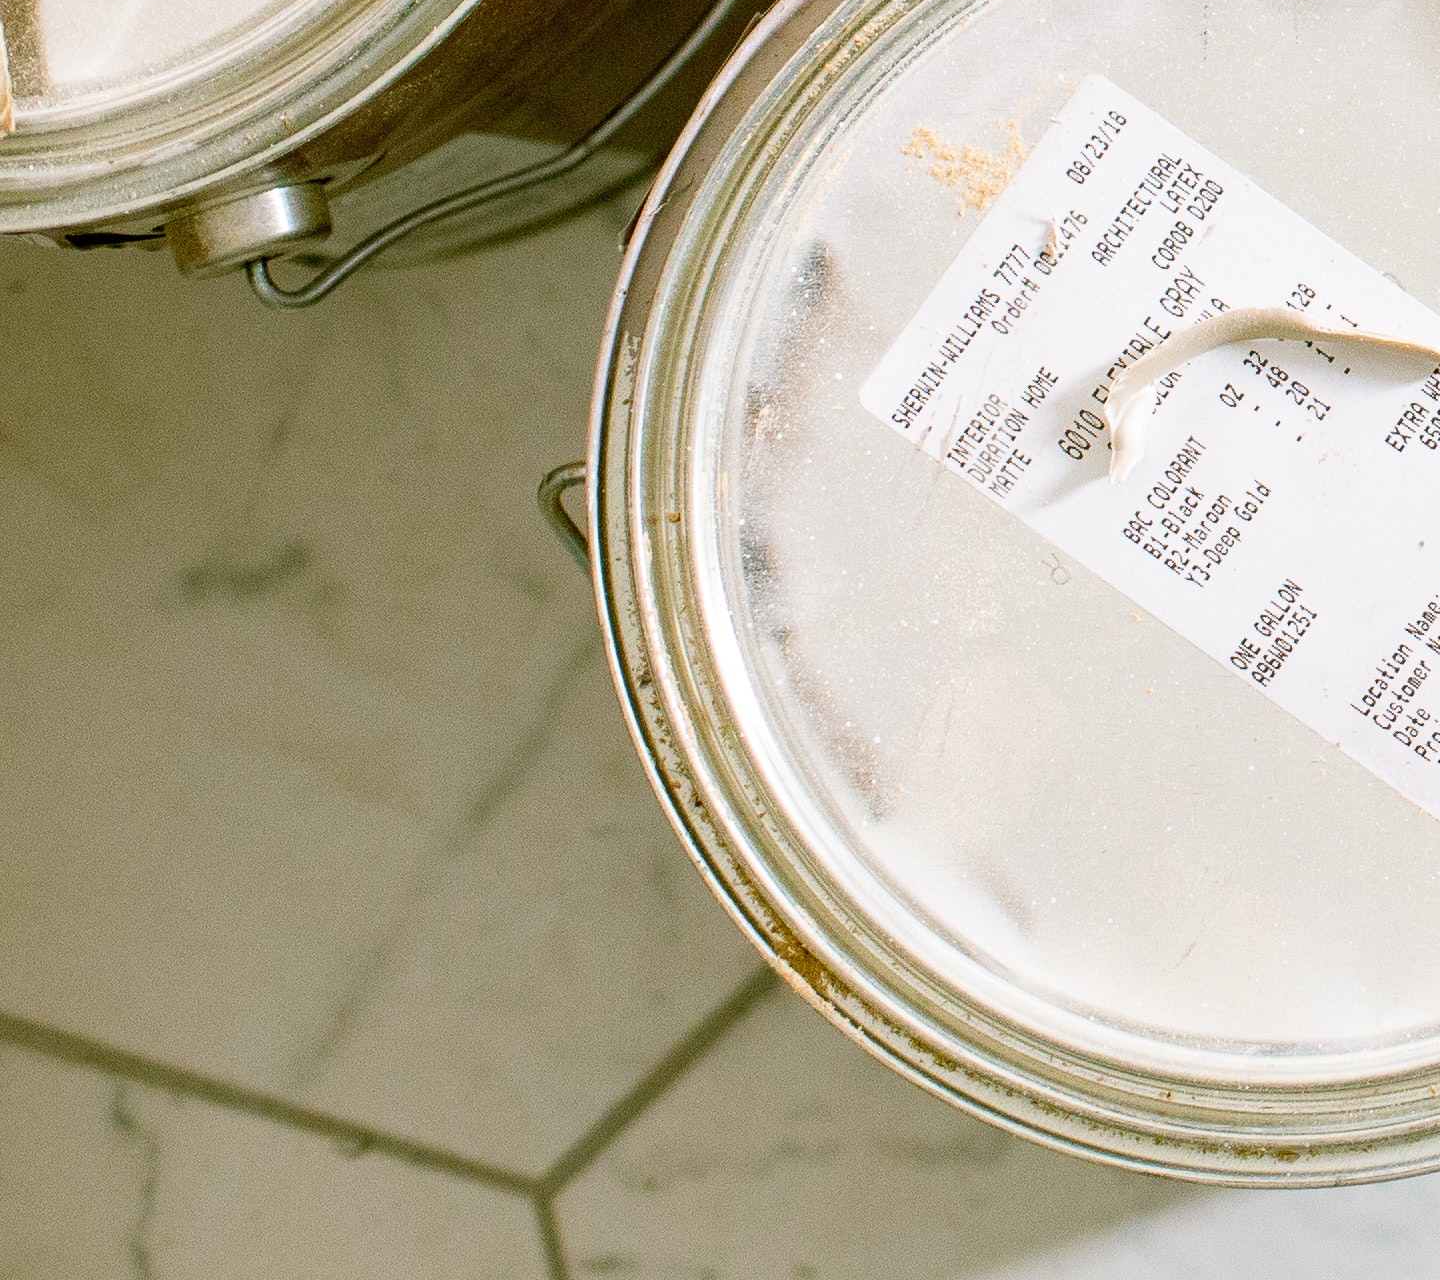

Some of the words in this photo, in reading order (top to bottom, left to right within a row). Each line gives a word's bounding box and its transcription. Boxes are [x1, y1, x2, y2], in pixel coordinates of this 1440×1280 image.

[890, 287, 1001, 429] SHERWIN-WILLIAMS
[991, 243, 1031, 286] 7777
[1064, 109, 1127, 185] 08/23/18
[945, 393, 1008, 469] INTERIOR
[1090, 152, 1183, 267] ARCHITECTURAL
[965, 406, 1030, 484] DURATION
[1020, 365, 1059, 409] HOME
[1158, 162, 1204, 214] LATEX
[987, 447, 1033, 498] MATTE
[1150, 219, 1194, 270] COROB
[1185, 178, 1224, 221] D200
[989, 275, 1041, 335] Order#
[1056, 407, 1106, 461] 6010
[1158, 263, 1205, 318] GRAY
[1121, 509, 1153, 545] BAC
[1145, 434, 1207, 510] COLORANT
[1218, 382, 1245, 408] OZ
[1241, 348, 1269, 375] 32
[1141, 485, 1205, 560] B1-Black
[1264, 365, 1289, 389] 48
[1162, 493, 1232, 576] R2-Maroon
[1284, 379, 1310, 406] 20
[1183, 525, 1242, 588] Y3-Deep
[1232, 478, 1272, 522] Gold
[1305, 396, 1332, 422] 21
[1228, 636, 1262, 671] ONE
[1252, 577, 1303, 637] GALLON
[1383, 401, 1430, 453] EXTRA
[1250, 603, 1318, 688] A96W01251
[1349, 642, 1413, 717] Location
[1371, 659, 1431, 731] Customer
[1391, 707, 1431, 747] Date
